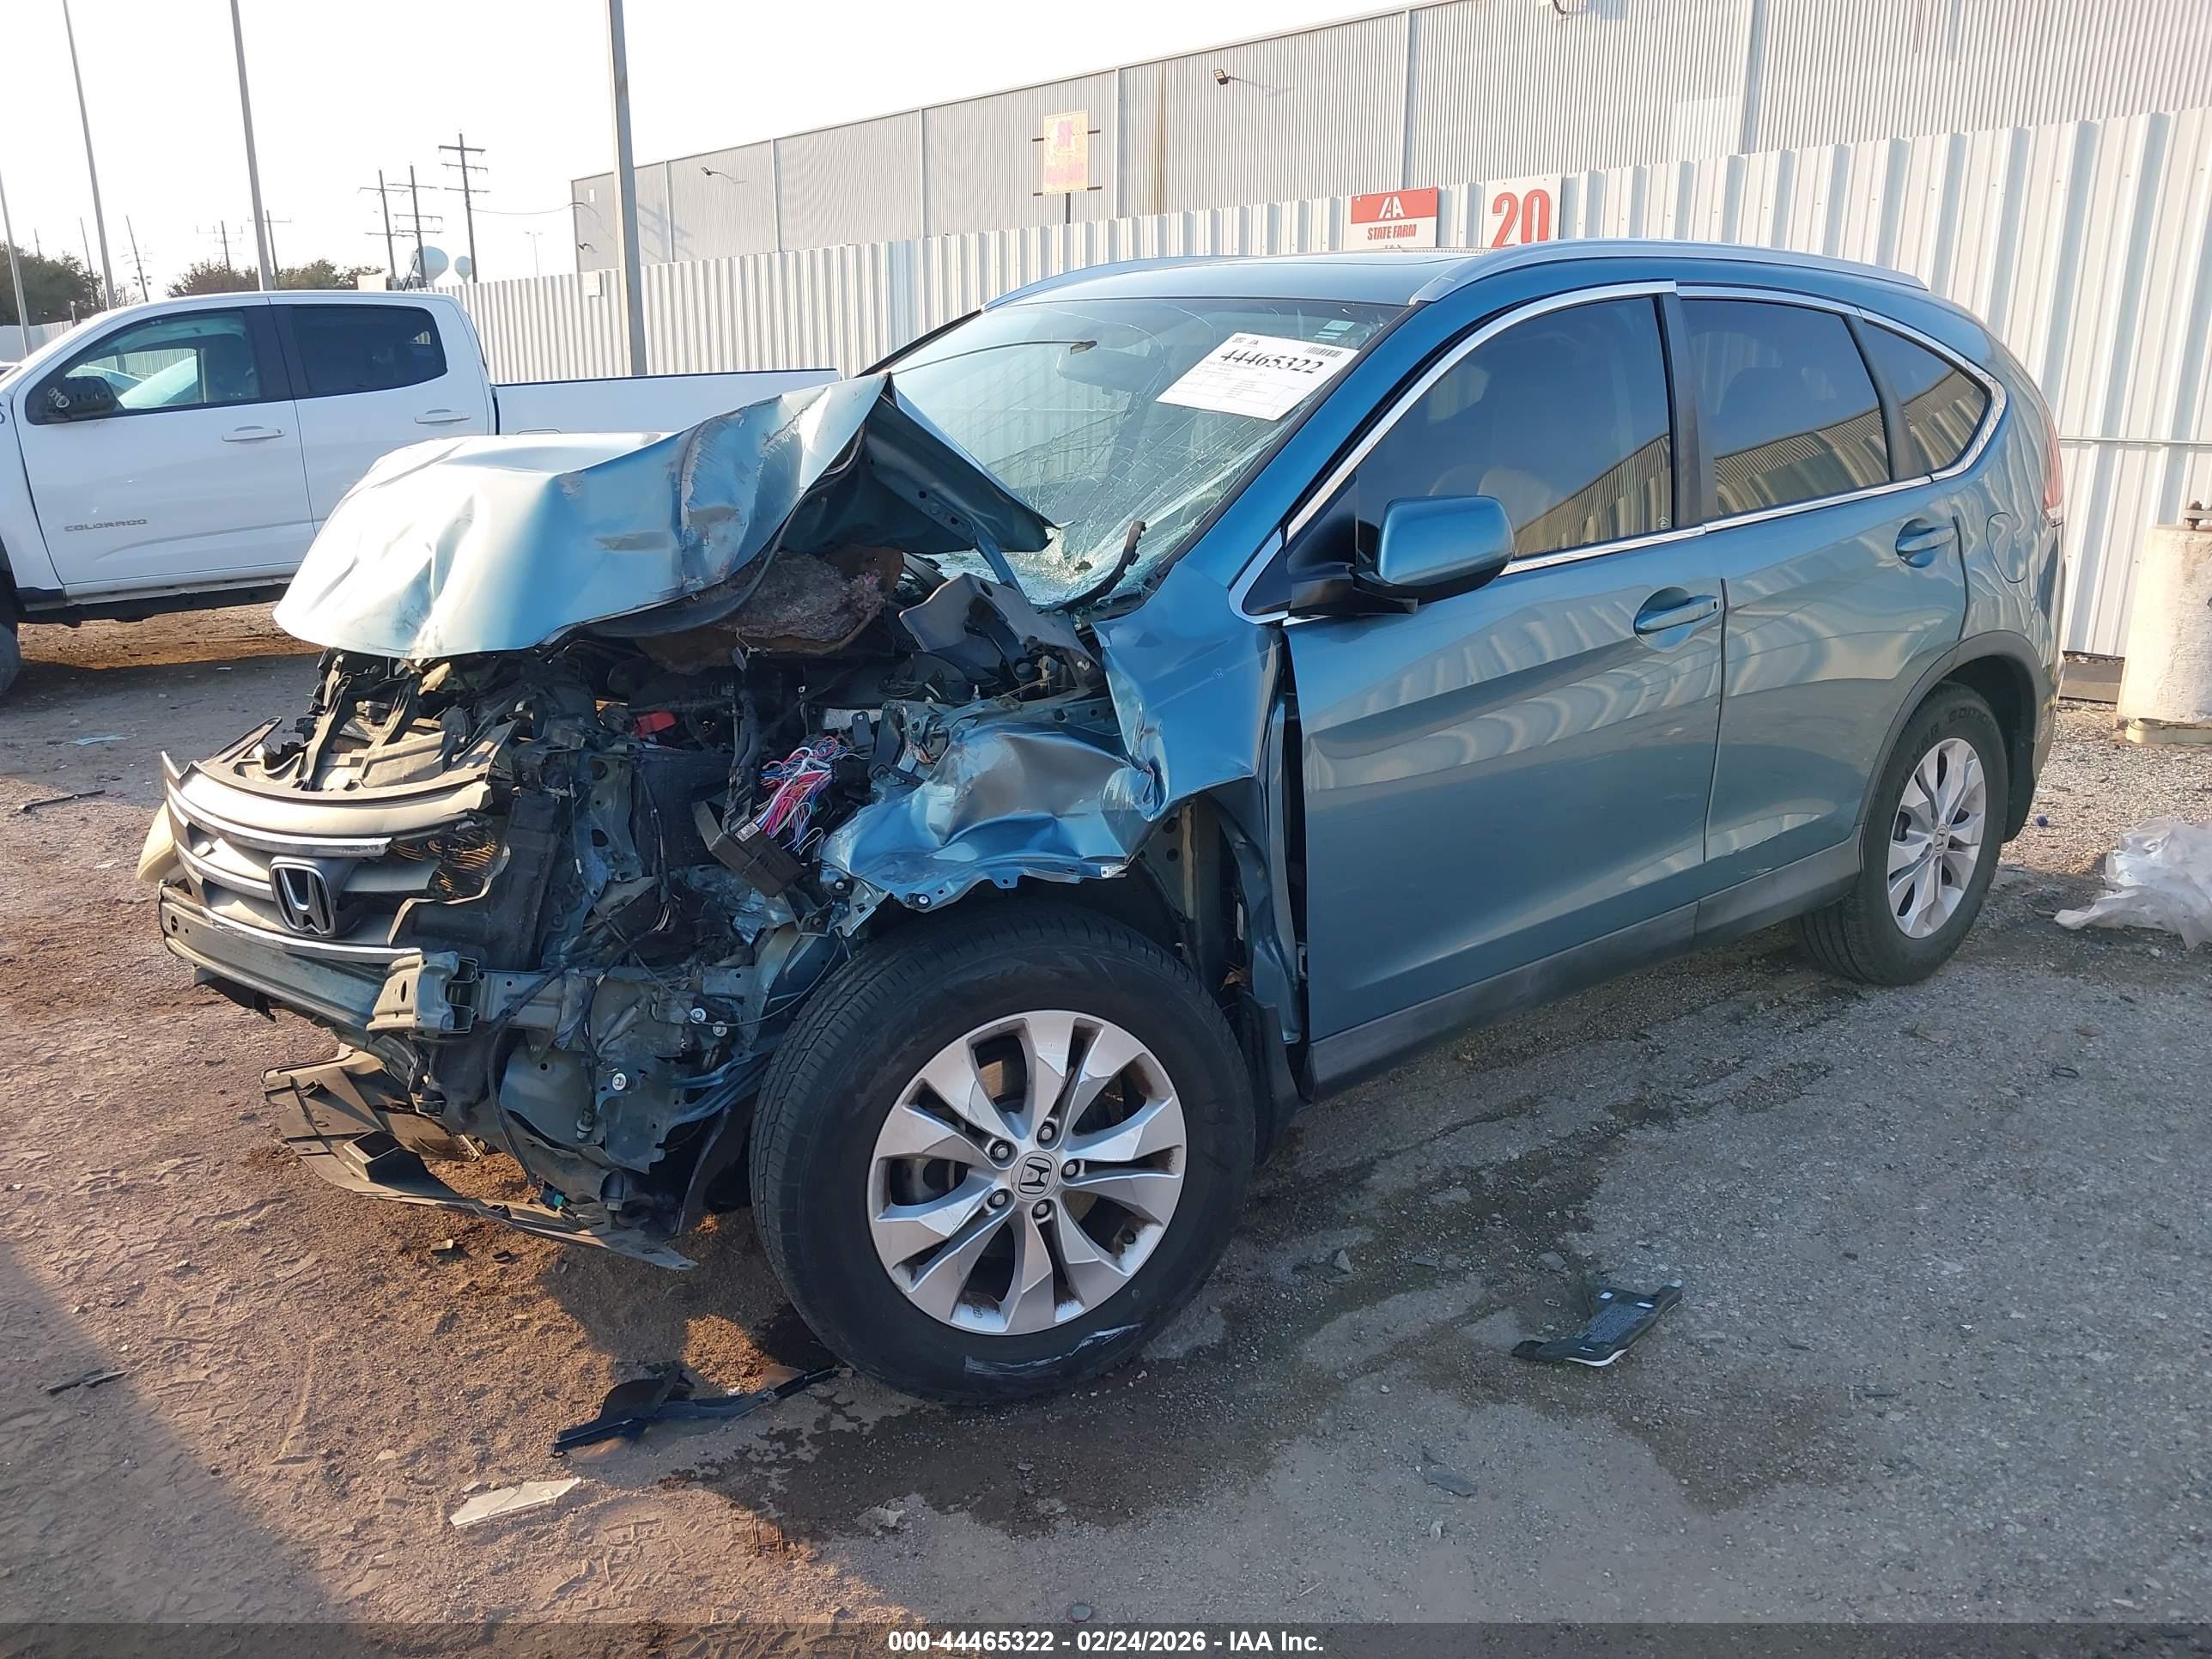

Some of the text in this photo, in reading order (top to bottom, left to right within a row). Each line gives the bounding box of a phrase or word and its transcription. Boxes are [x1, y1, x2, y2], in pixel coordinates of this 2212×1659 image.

[1492, 189, 1552, 247] 20
[1367, 223, 1418, 240] STATE FARM
[1220, 349, 1325, 374] 44465322
[64, 519, 148, 532] COLORADO
